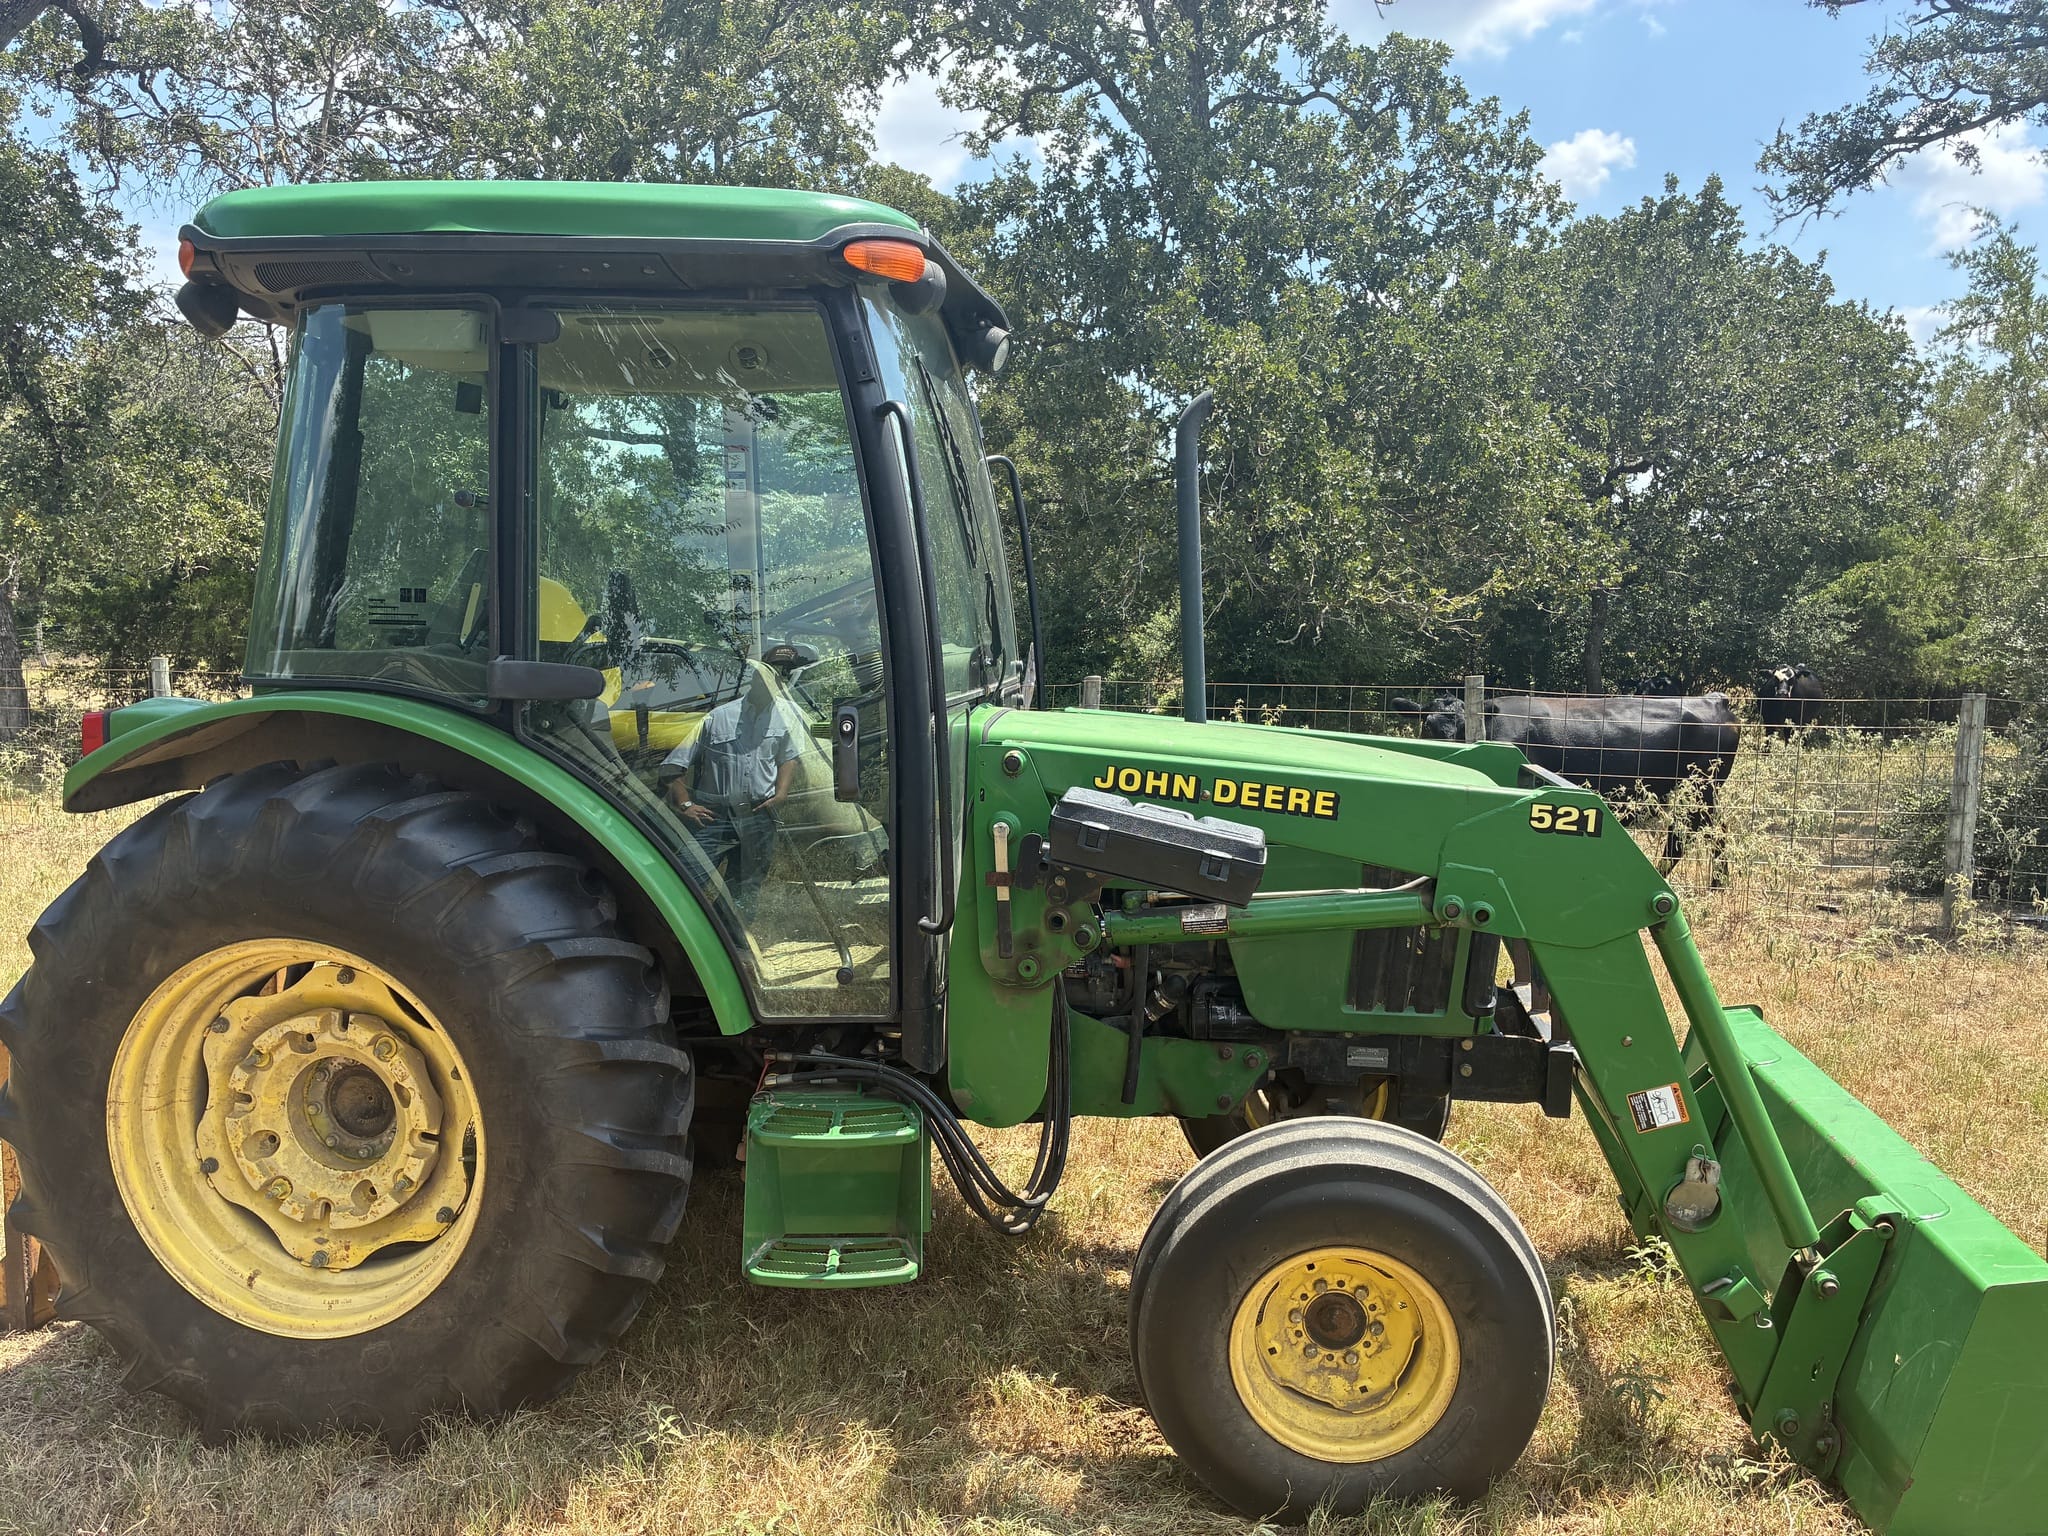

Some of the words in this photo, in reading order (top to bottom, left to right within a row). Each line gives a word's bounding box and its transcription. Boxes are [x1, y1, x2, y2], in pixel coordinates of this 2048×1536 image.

[1094, 765, 1198, 800] JOHN
[1212, 778, 1338, 818] DEERE
[1529, 803, 1600, 835] 521
